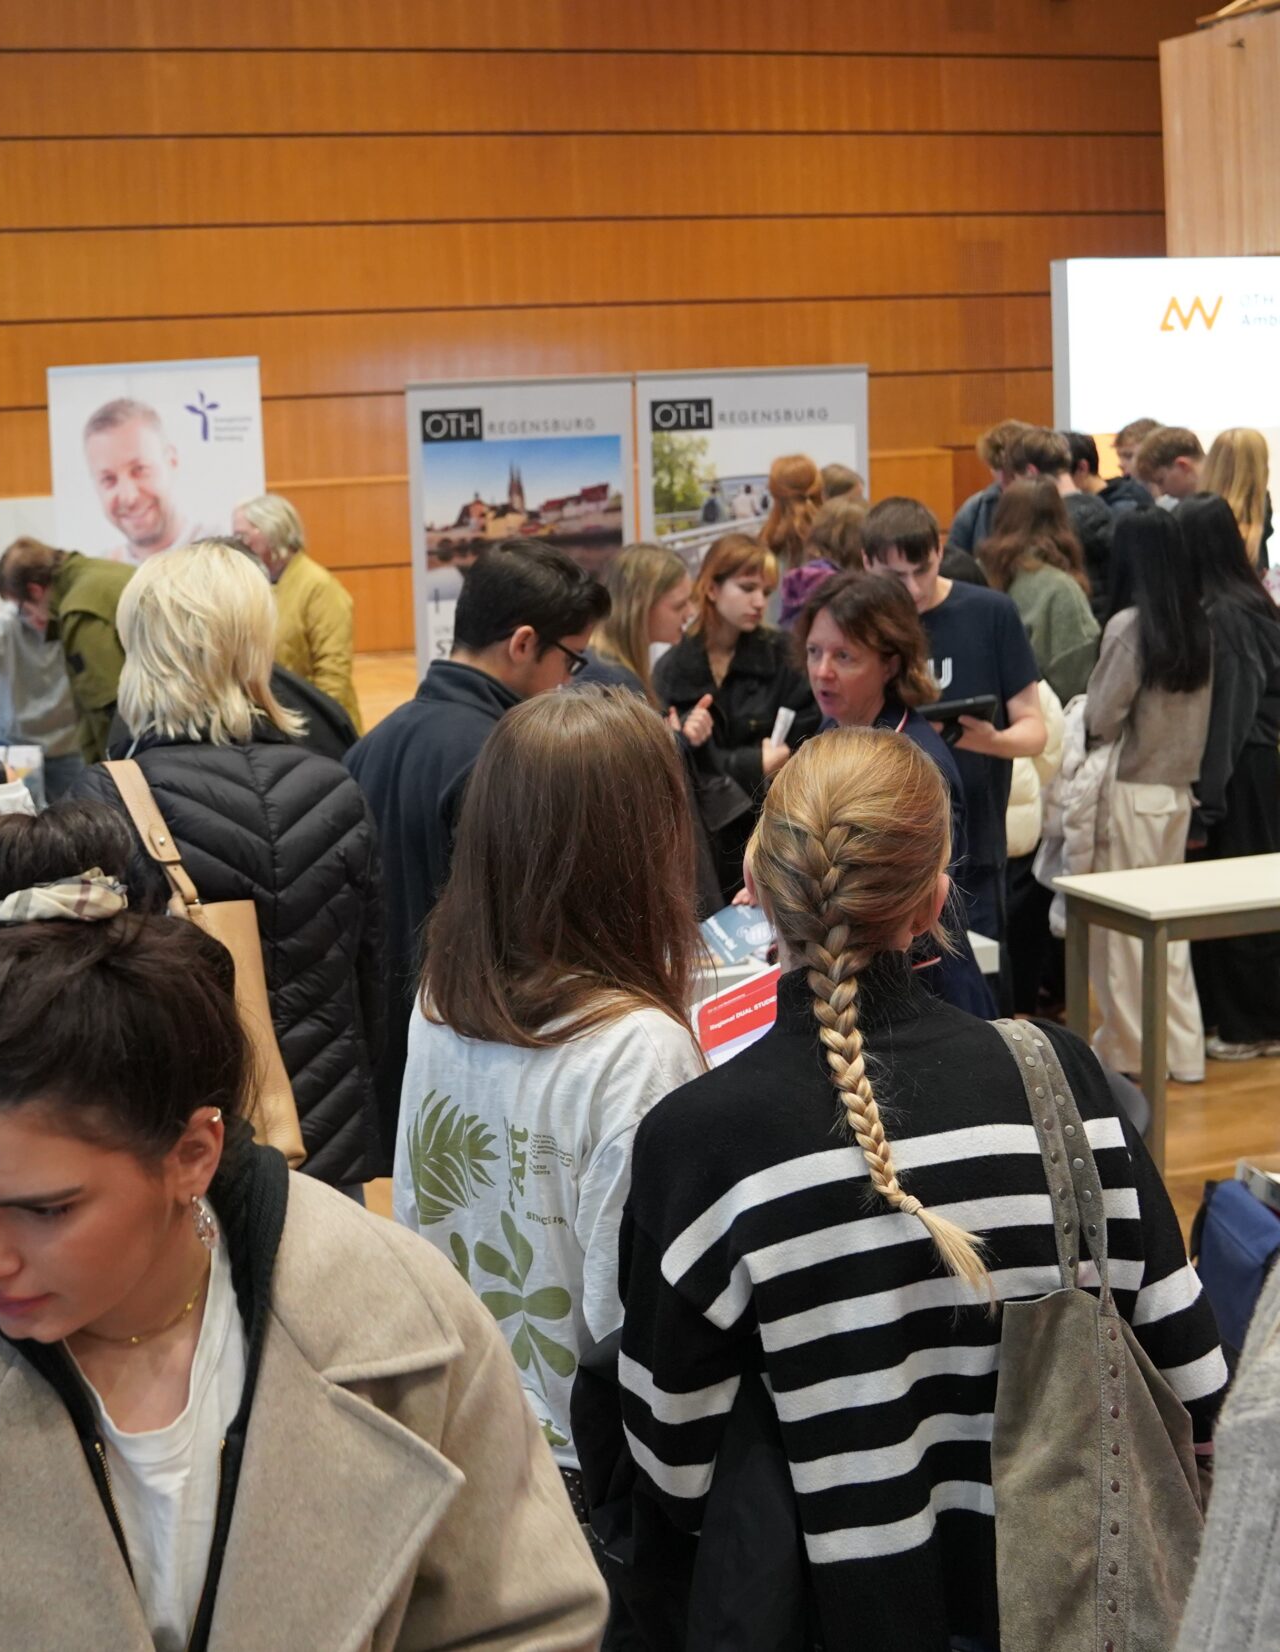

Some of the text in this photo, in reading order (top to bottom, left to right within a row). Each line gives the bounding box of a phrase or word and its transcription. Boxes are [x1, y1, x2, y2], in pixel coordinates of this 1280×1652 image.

[1241, 314, 1280, 327] Amb
[654, 403, 829, 429] OTH REGENSBURG
[424, 412, 596, 439] OTH REGENSBURG
[735, 1008, 753, 1019] DUAL
[526, 1211, 552, 1225] SINCE
